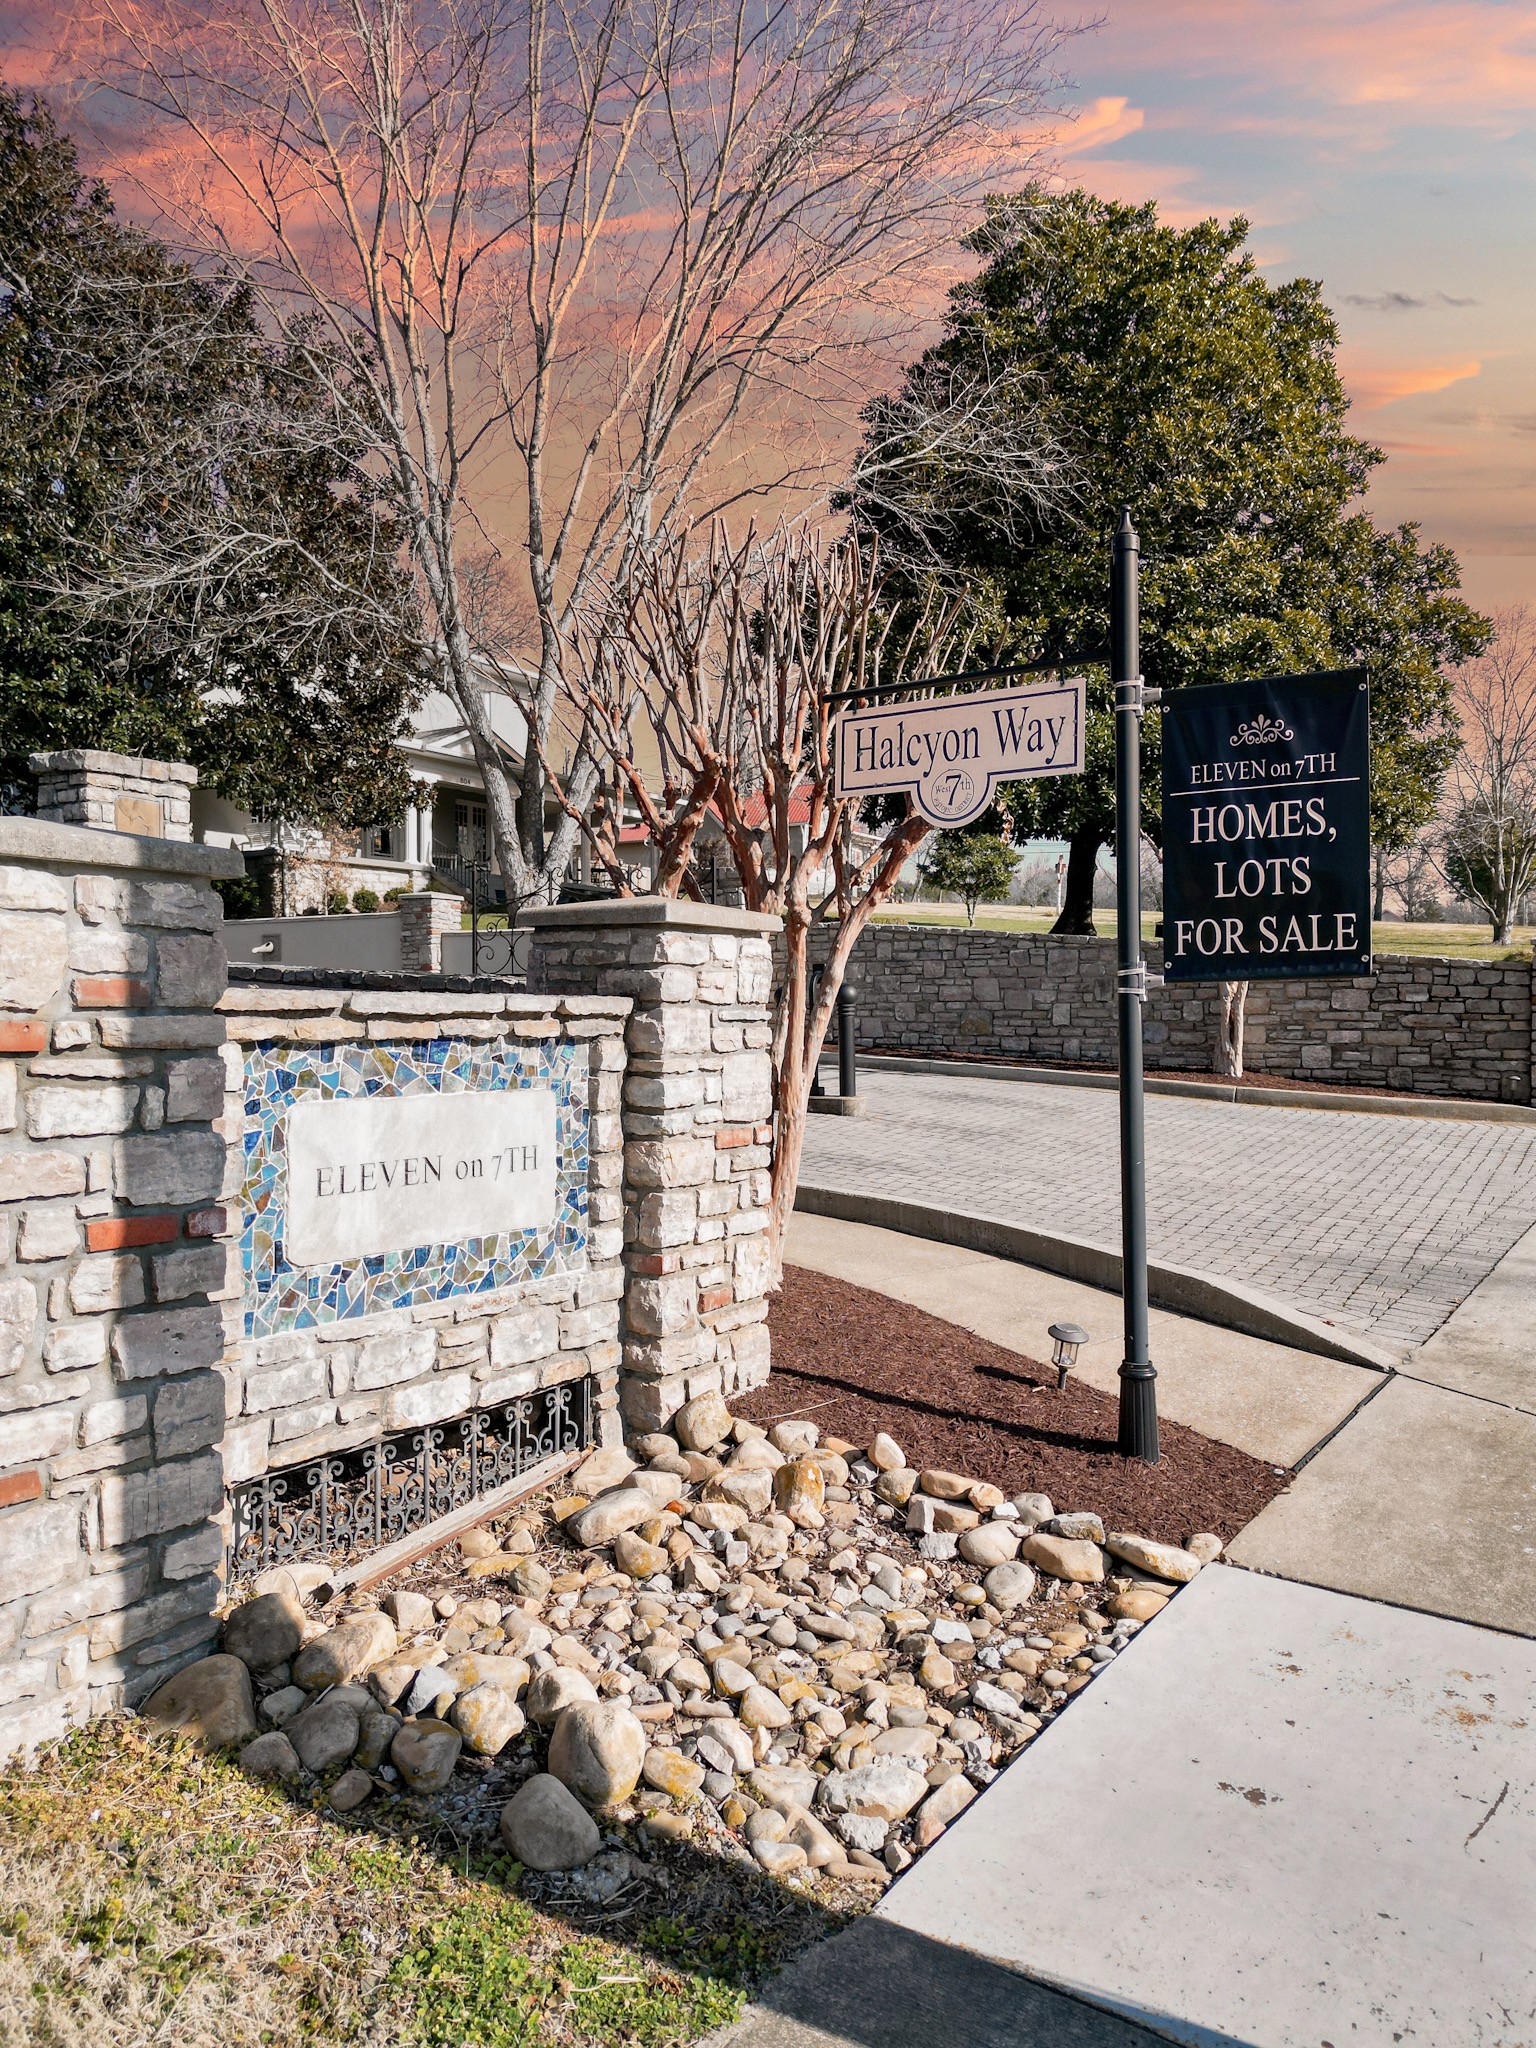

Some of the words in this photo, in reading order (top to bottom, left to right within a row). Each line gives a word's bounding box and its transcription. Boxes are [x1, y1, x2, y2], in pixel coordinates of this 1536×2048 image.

[853, 720, 980, 777] Halcyon
[991, 706, 1067, 764] Way
[460, 777, 471, 785] 804
[1190, 759, 1266, 784] ELEVEN
[1270, 762, 1291, 777] on
[1295, 752, 1336, 779] 7TH
[935, 785, 951, 794] West
[1190, 797, 1337, 843] HOMES,
[1214, 856, 1312, 898] LOTS
[1174, 918, 1249, 956] FOR
[1259, 913, 1358, 954] SALE
[315, 1155, 443, 1197] ELEVEN
[455, 1158, 483, 1180] on
[492, 1145, 539, 1181] 7TH
